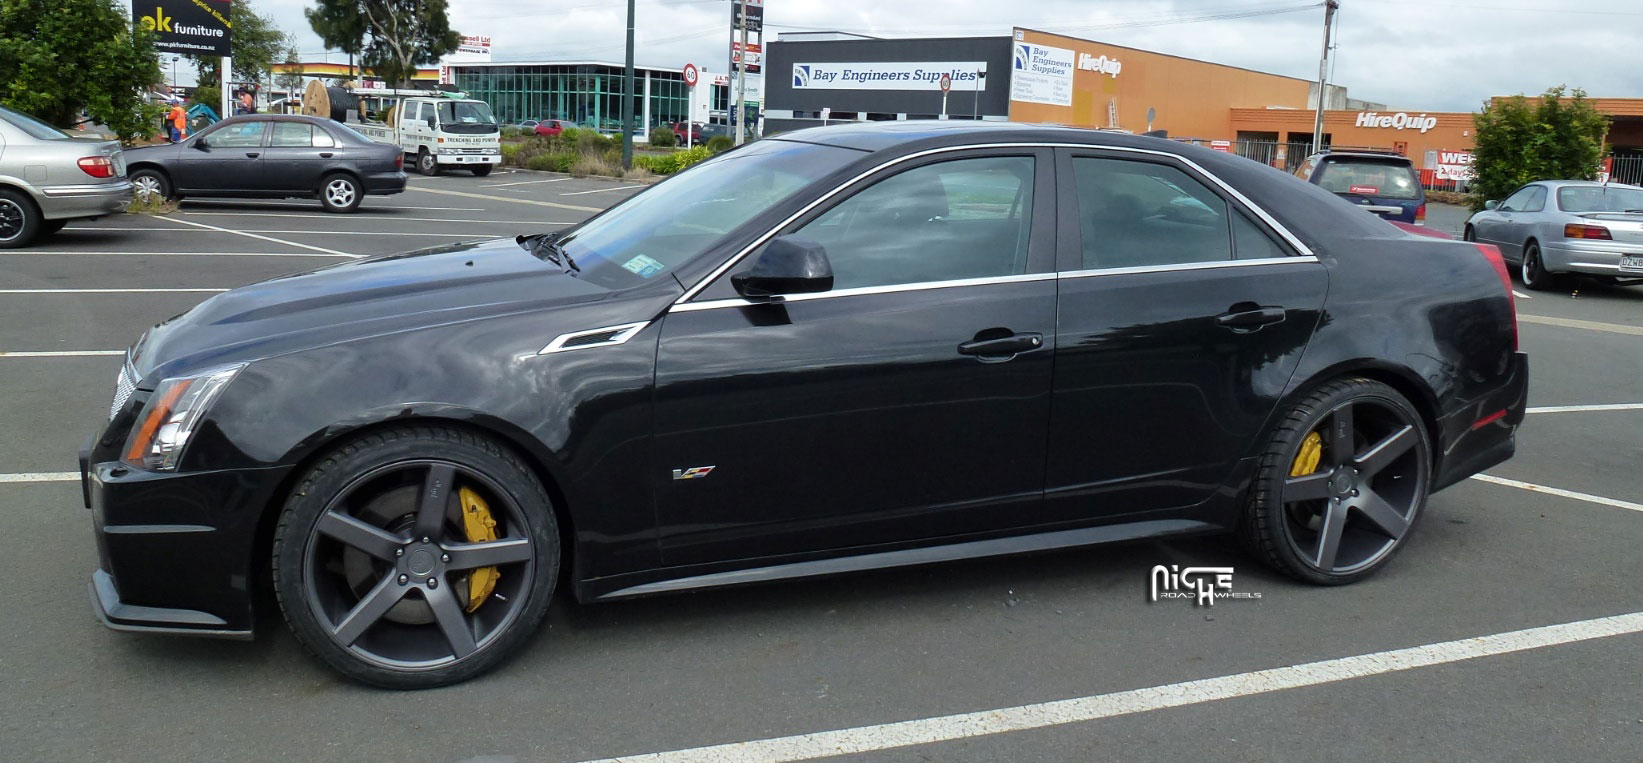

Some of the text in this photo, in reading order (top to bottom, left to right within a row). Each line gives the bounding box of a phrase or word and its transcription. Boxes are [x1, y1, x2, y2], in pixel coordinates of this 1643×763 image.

[174, 22, 224, 37] furniture
[1033, 47, 1049, 58] Bay
[1032, 55, 1072, 68] Engineers
[1078, 53, 1121, 78] HireQuip
[1031, 64, 1066, 75] Supplies
[813, 70, 837, 82] Bay
[841, 70, 910, 83] Engineers
[1355, 112, 1437, 134] HireQuip
